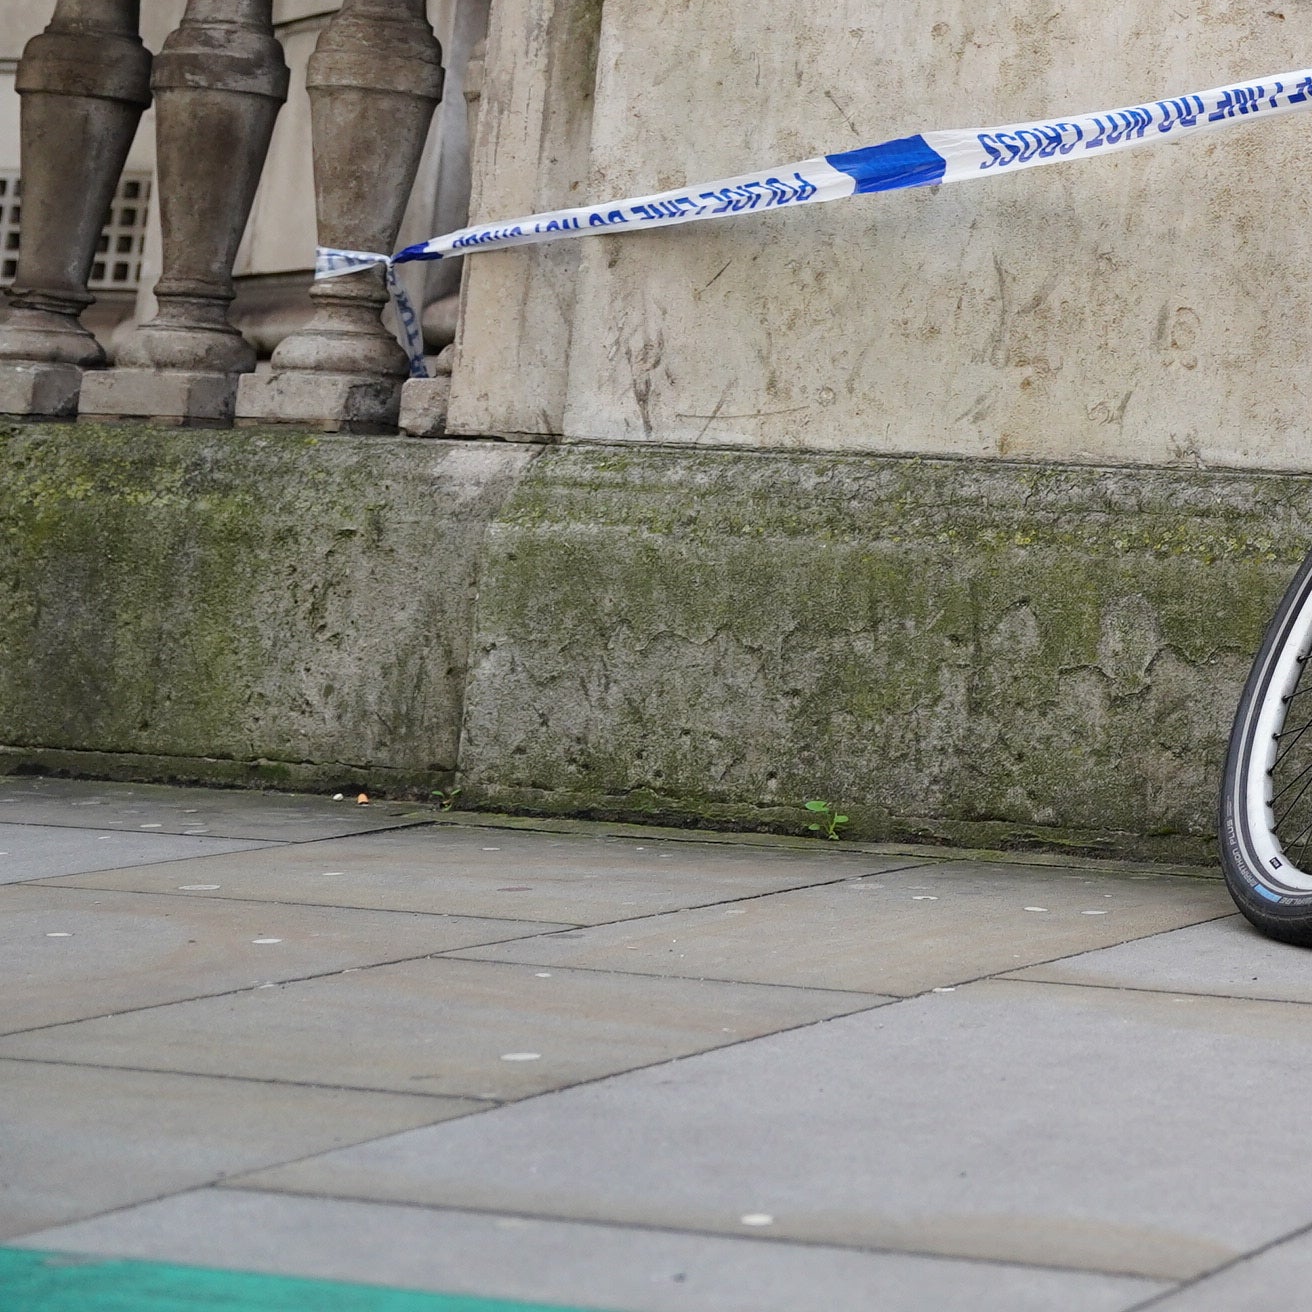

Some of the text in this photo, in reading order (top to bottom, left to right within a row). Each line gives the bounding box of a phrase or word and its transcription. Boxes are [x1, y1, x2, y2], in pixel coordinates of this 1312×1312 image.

[978, 122, 1083, 170] CROSS
[1085, 106, 1153, 149] NOT
[699, 172, 819, 215] POLICE
[1226, 818, 1237, 846] PLUS
